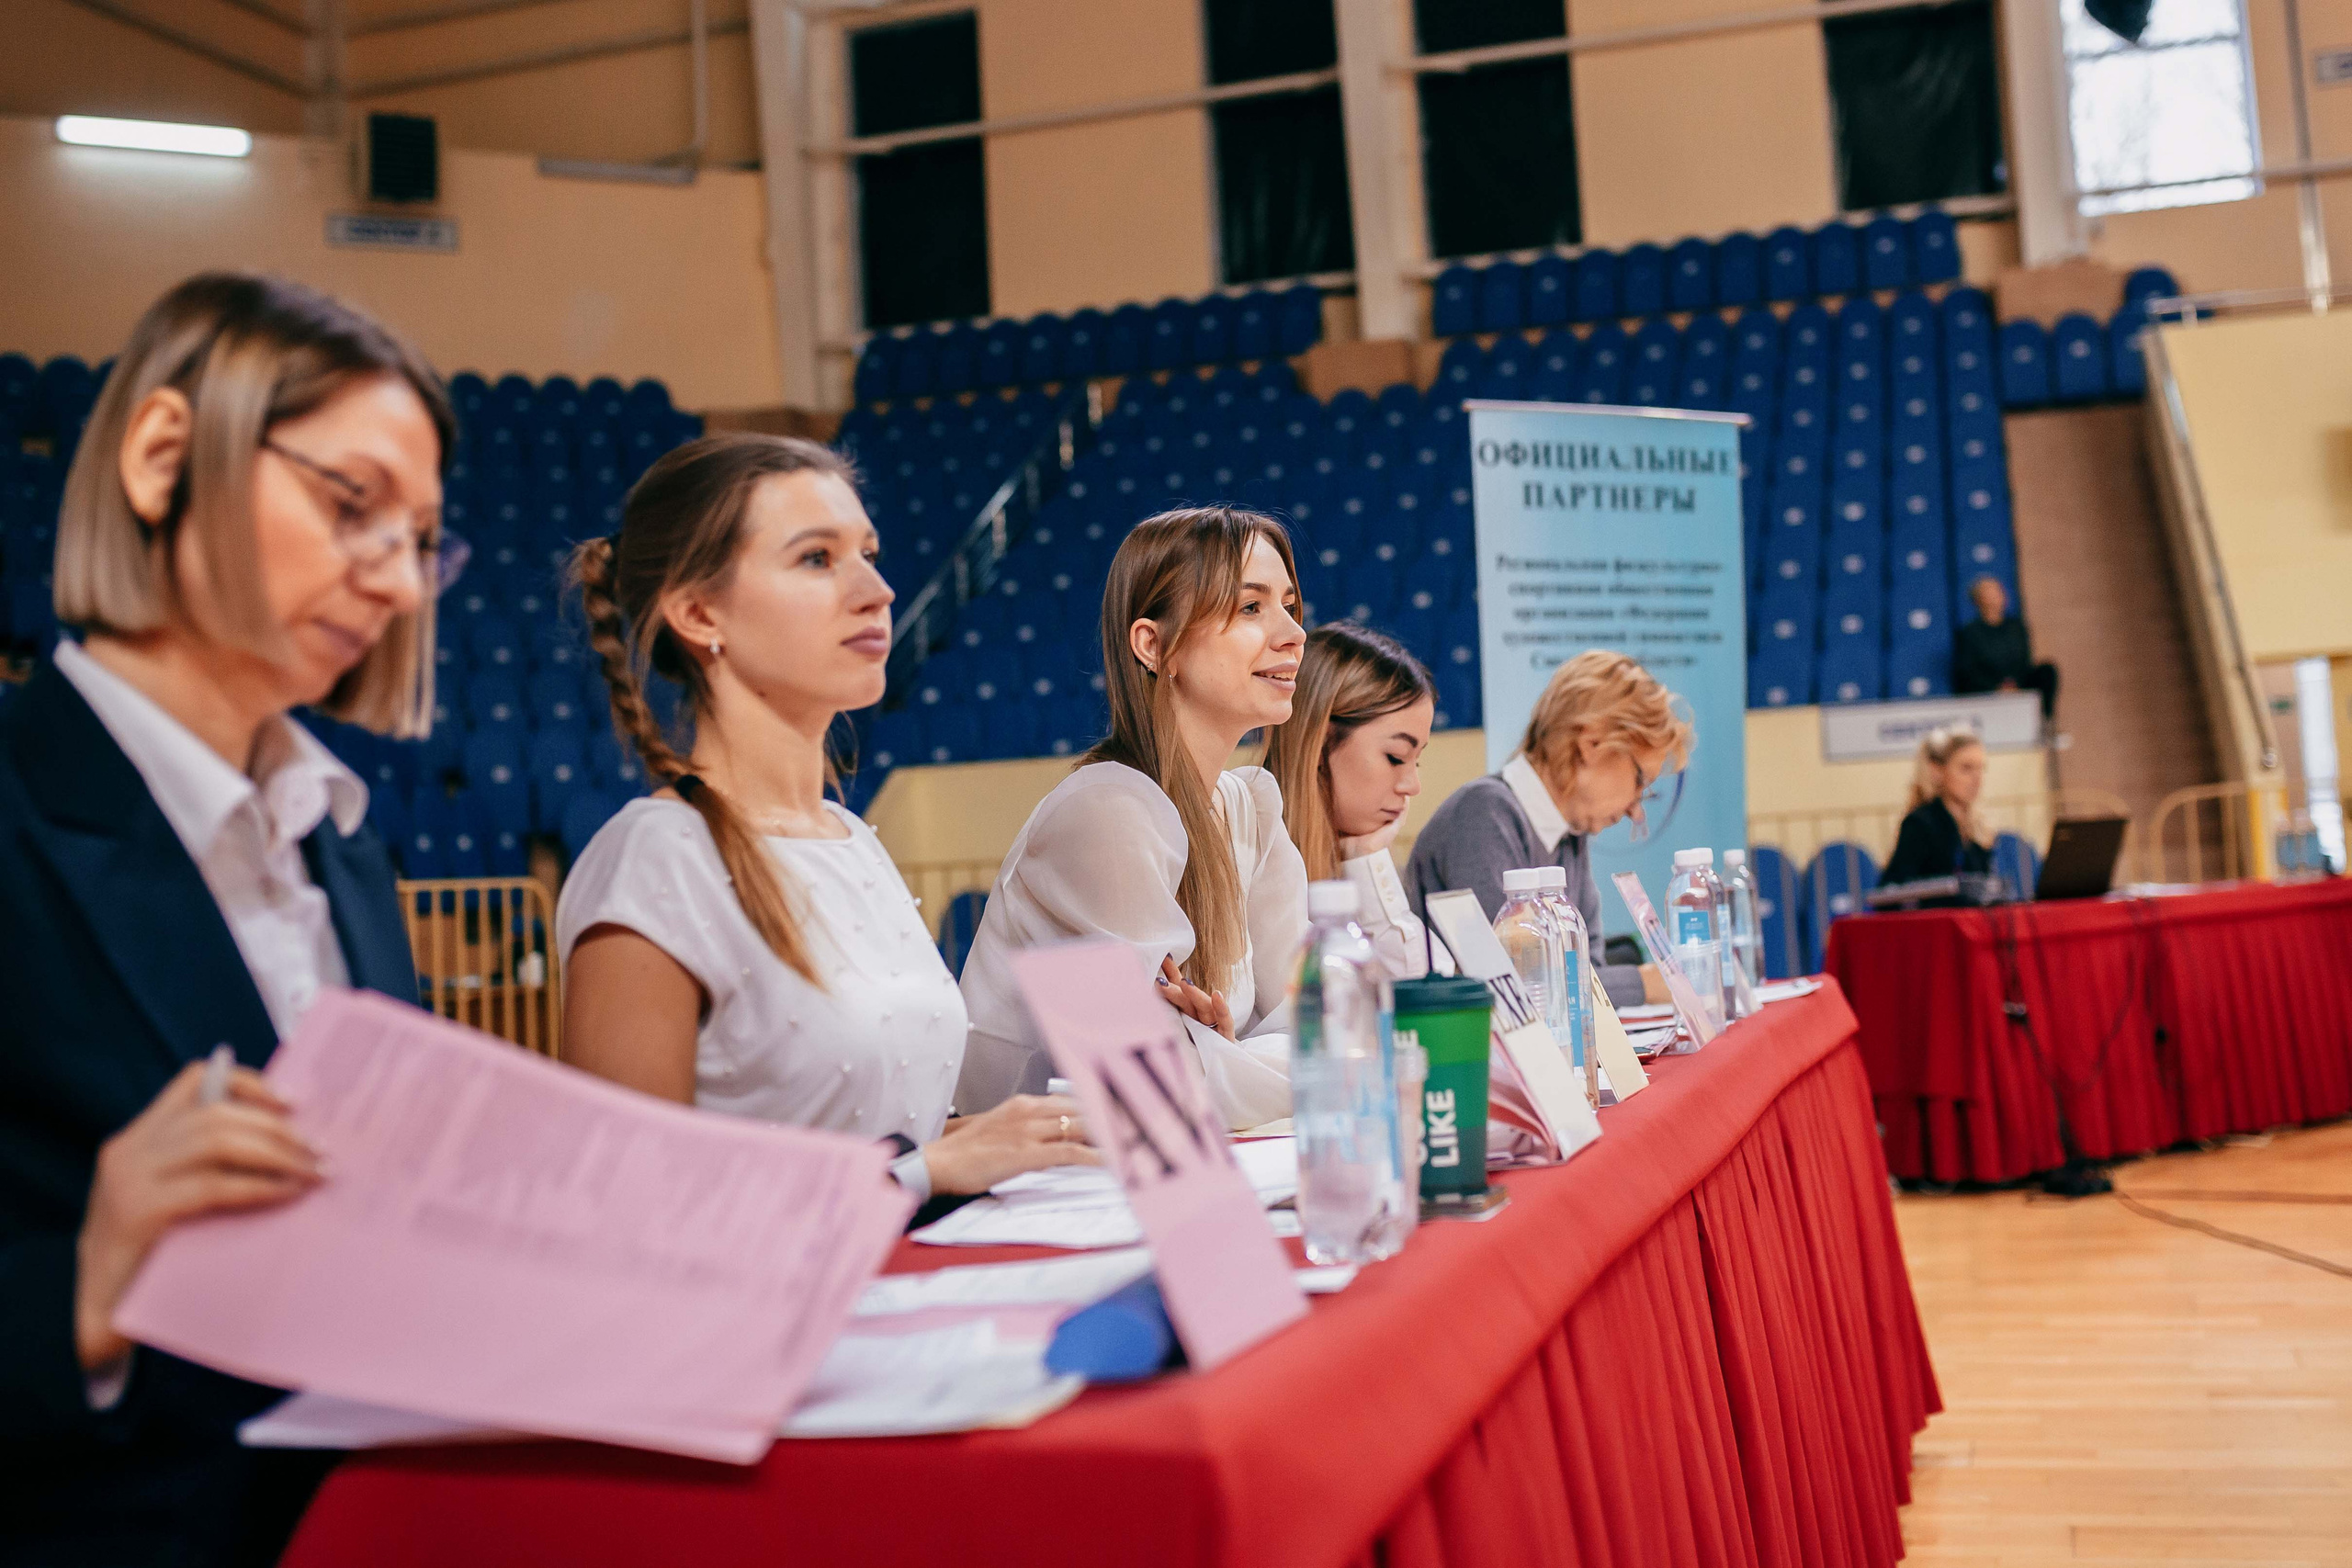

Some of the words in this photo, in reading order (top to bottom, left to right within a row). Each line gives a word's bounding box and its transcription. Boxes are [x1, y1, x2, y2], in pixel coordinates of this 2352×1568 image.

[1477, 439, 1731, 475] ОФИЦИАЛЬНЫЕ
[1521, 480, 1696, 513] ПАРТНЕРЫ
[1426, 1088, 1460, 1168] LIKE
